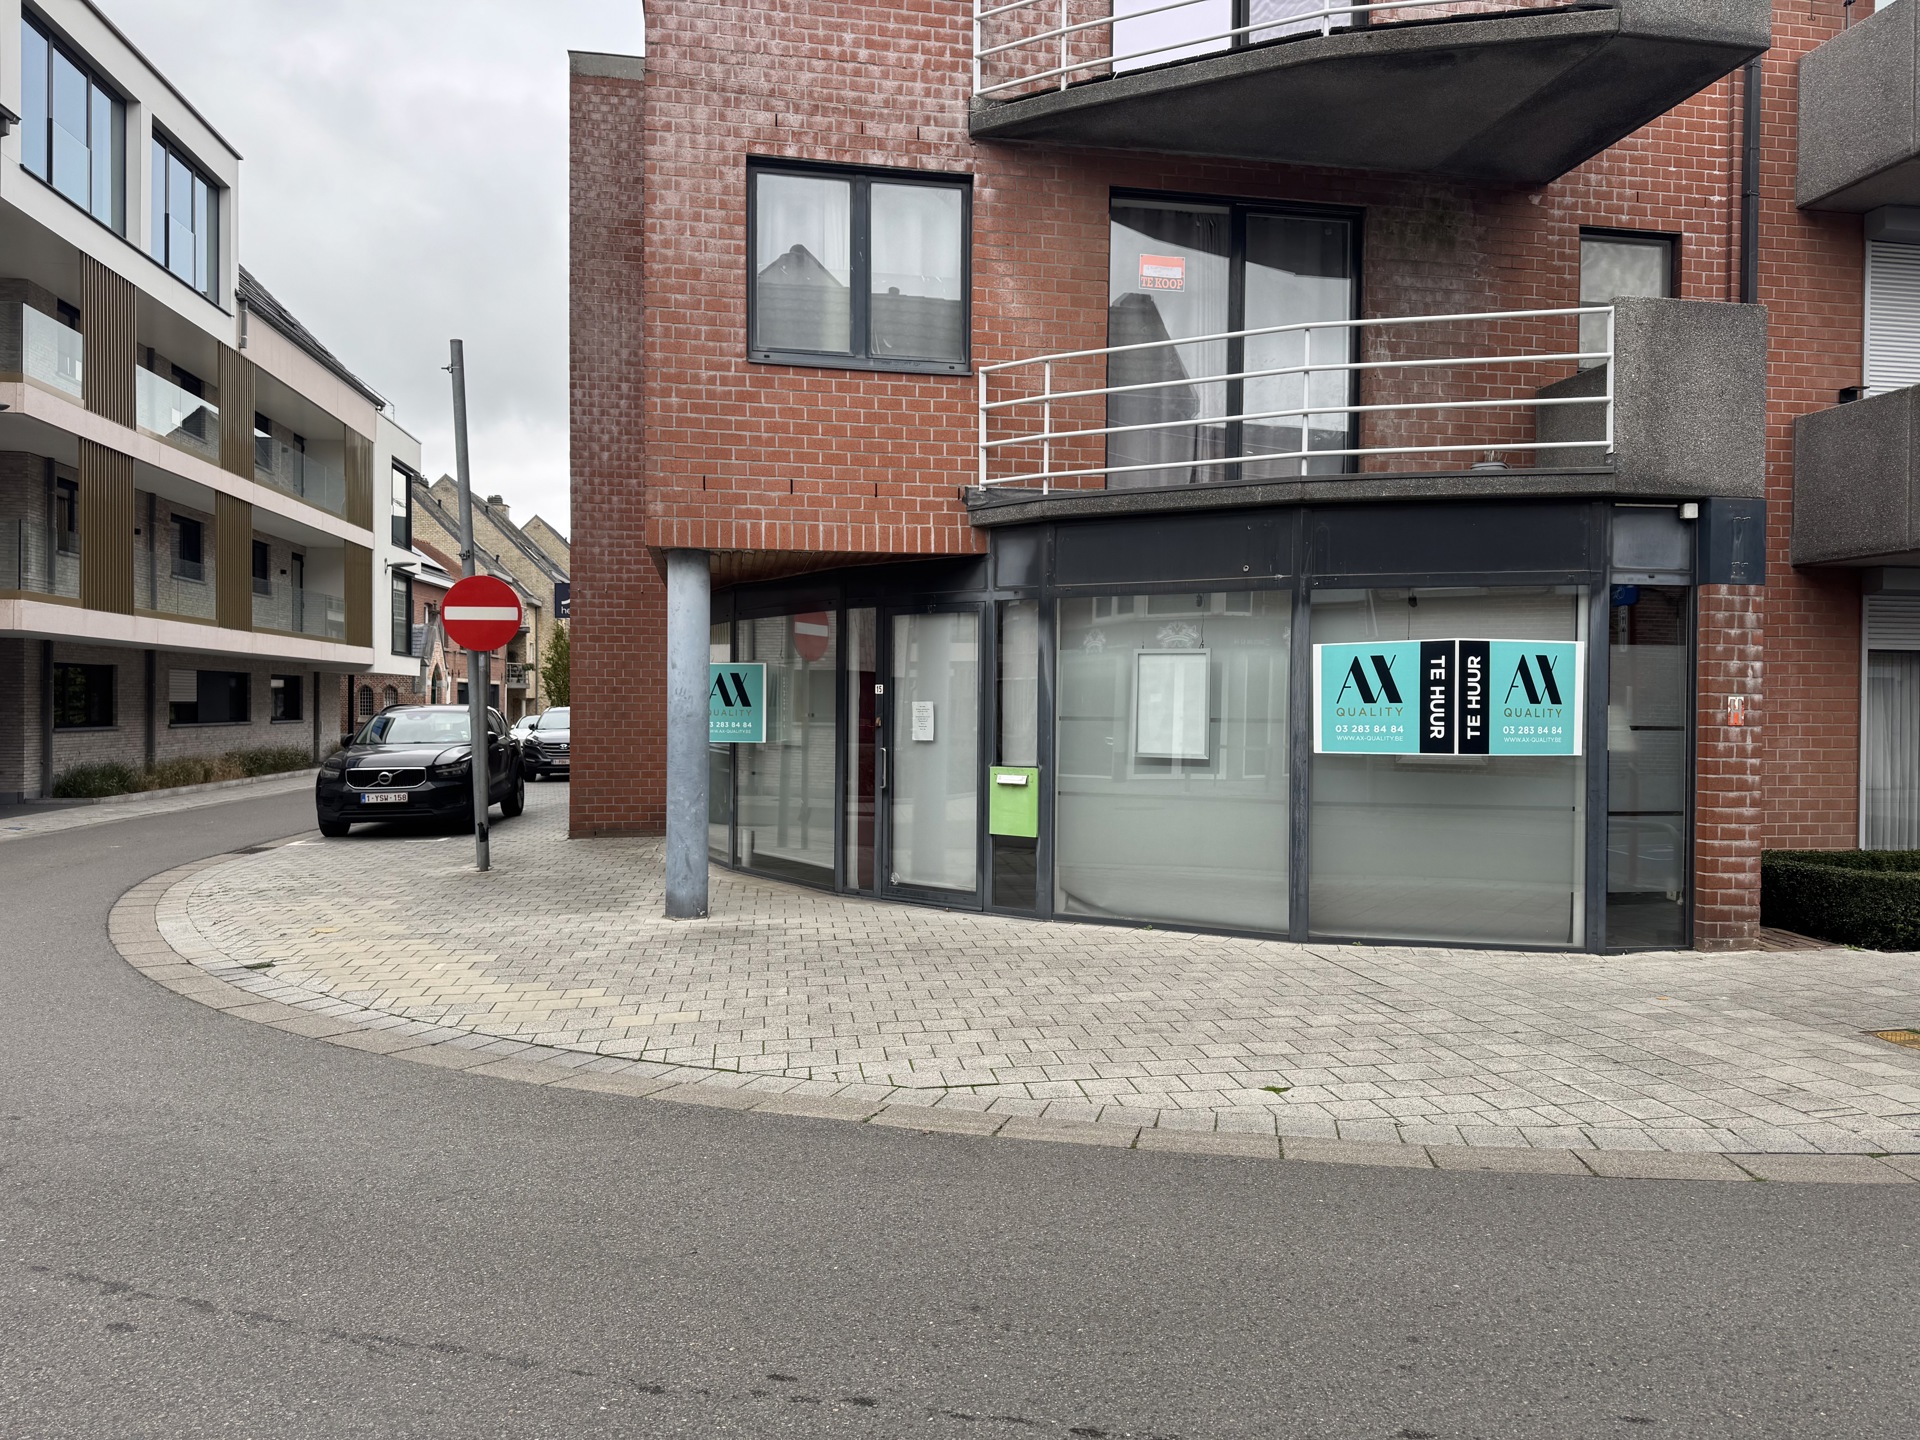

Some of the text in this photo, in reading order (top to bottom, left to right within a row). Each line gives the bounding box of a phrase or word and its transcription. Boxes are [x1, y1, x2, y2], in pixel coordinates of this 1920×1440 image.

[1141, 276, 1184, 289] TE KOOP
[709, 672, 752, 707] AX
[1336, 654, 1403, 704] AX
[1504, 654, 1562, 705] AX
[1429, 655, 1446, 739] TE HUUR
[1467, 655, 1481, 740] TE HUUR
[1336, 707, 1404, 717] QUALITY
[1503, 707, 1562, 718] QUALITY
[1335, 725, 1404, 733] 03 283 84 84
[1502, 726, 1562, 734] 03 283 84 84
